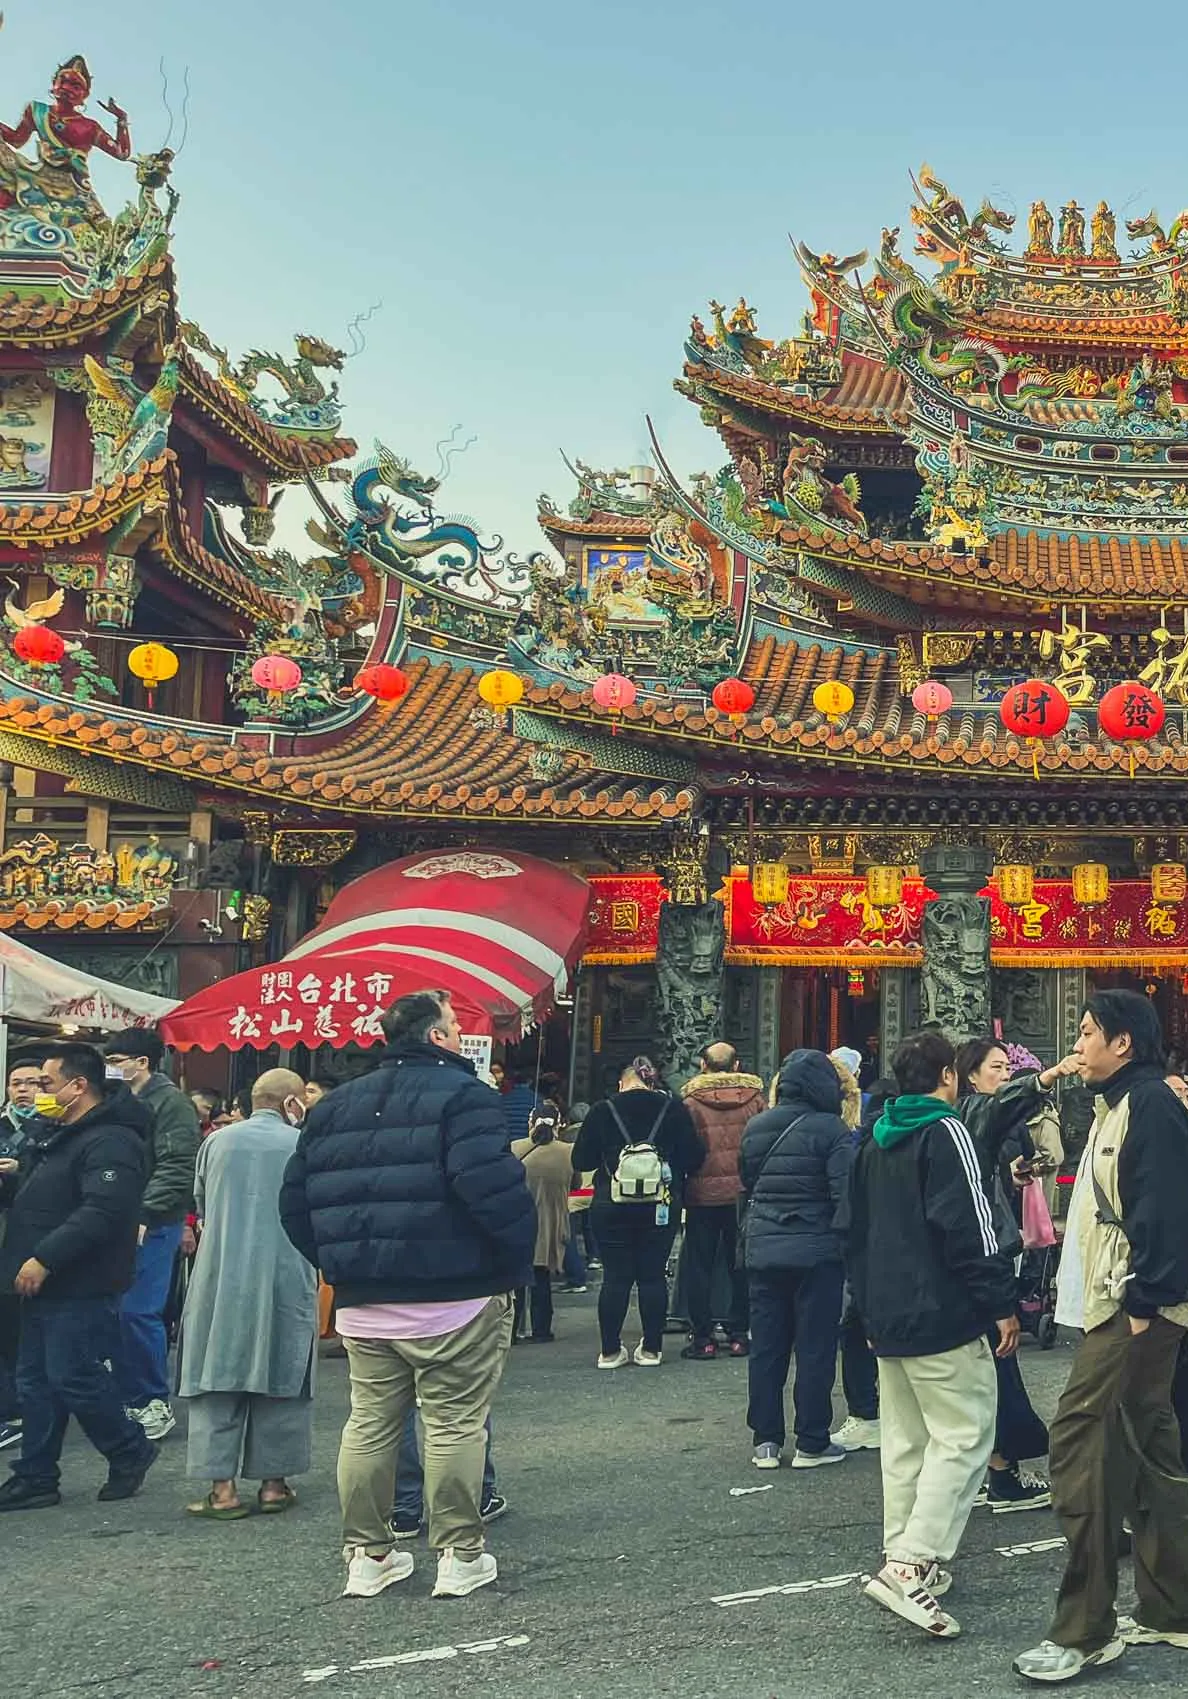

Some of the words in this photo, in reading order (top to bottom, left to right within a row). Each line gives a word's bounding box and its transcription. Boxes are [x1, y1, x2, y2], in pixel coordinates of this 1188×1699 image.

[1012, 690, 1050, 725] 財
[1120, 693, 1157, 729] 發
[611, 902, 639, 931] 國
[297, 971, 394, 1003] 台北市
